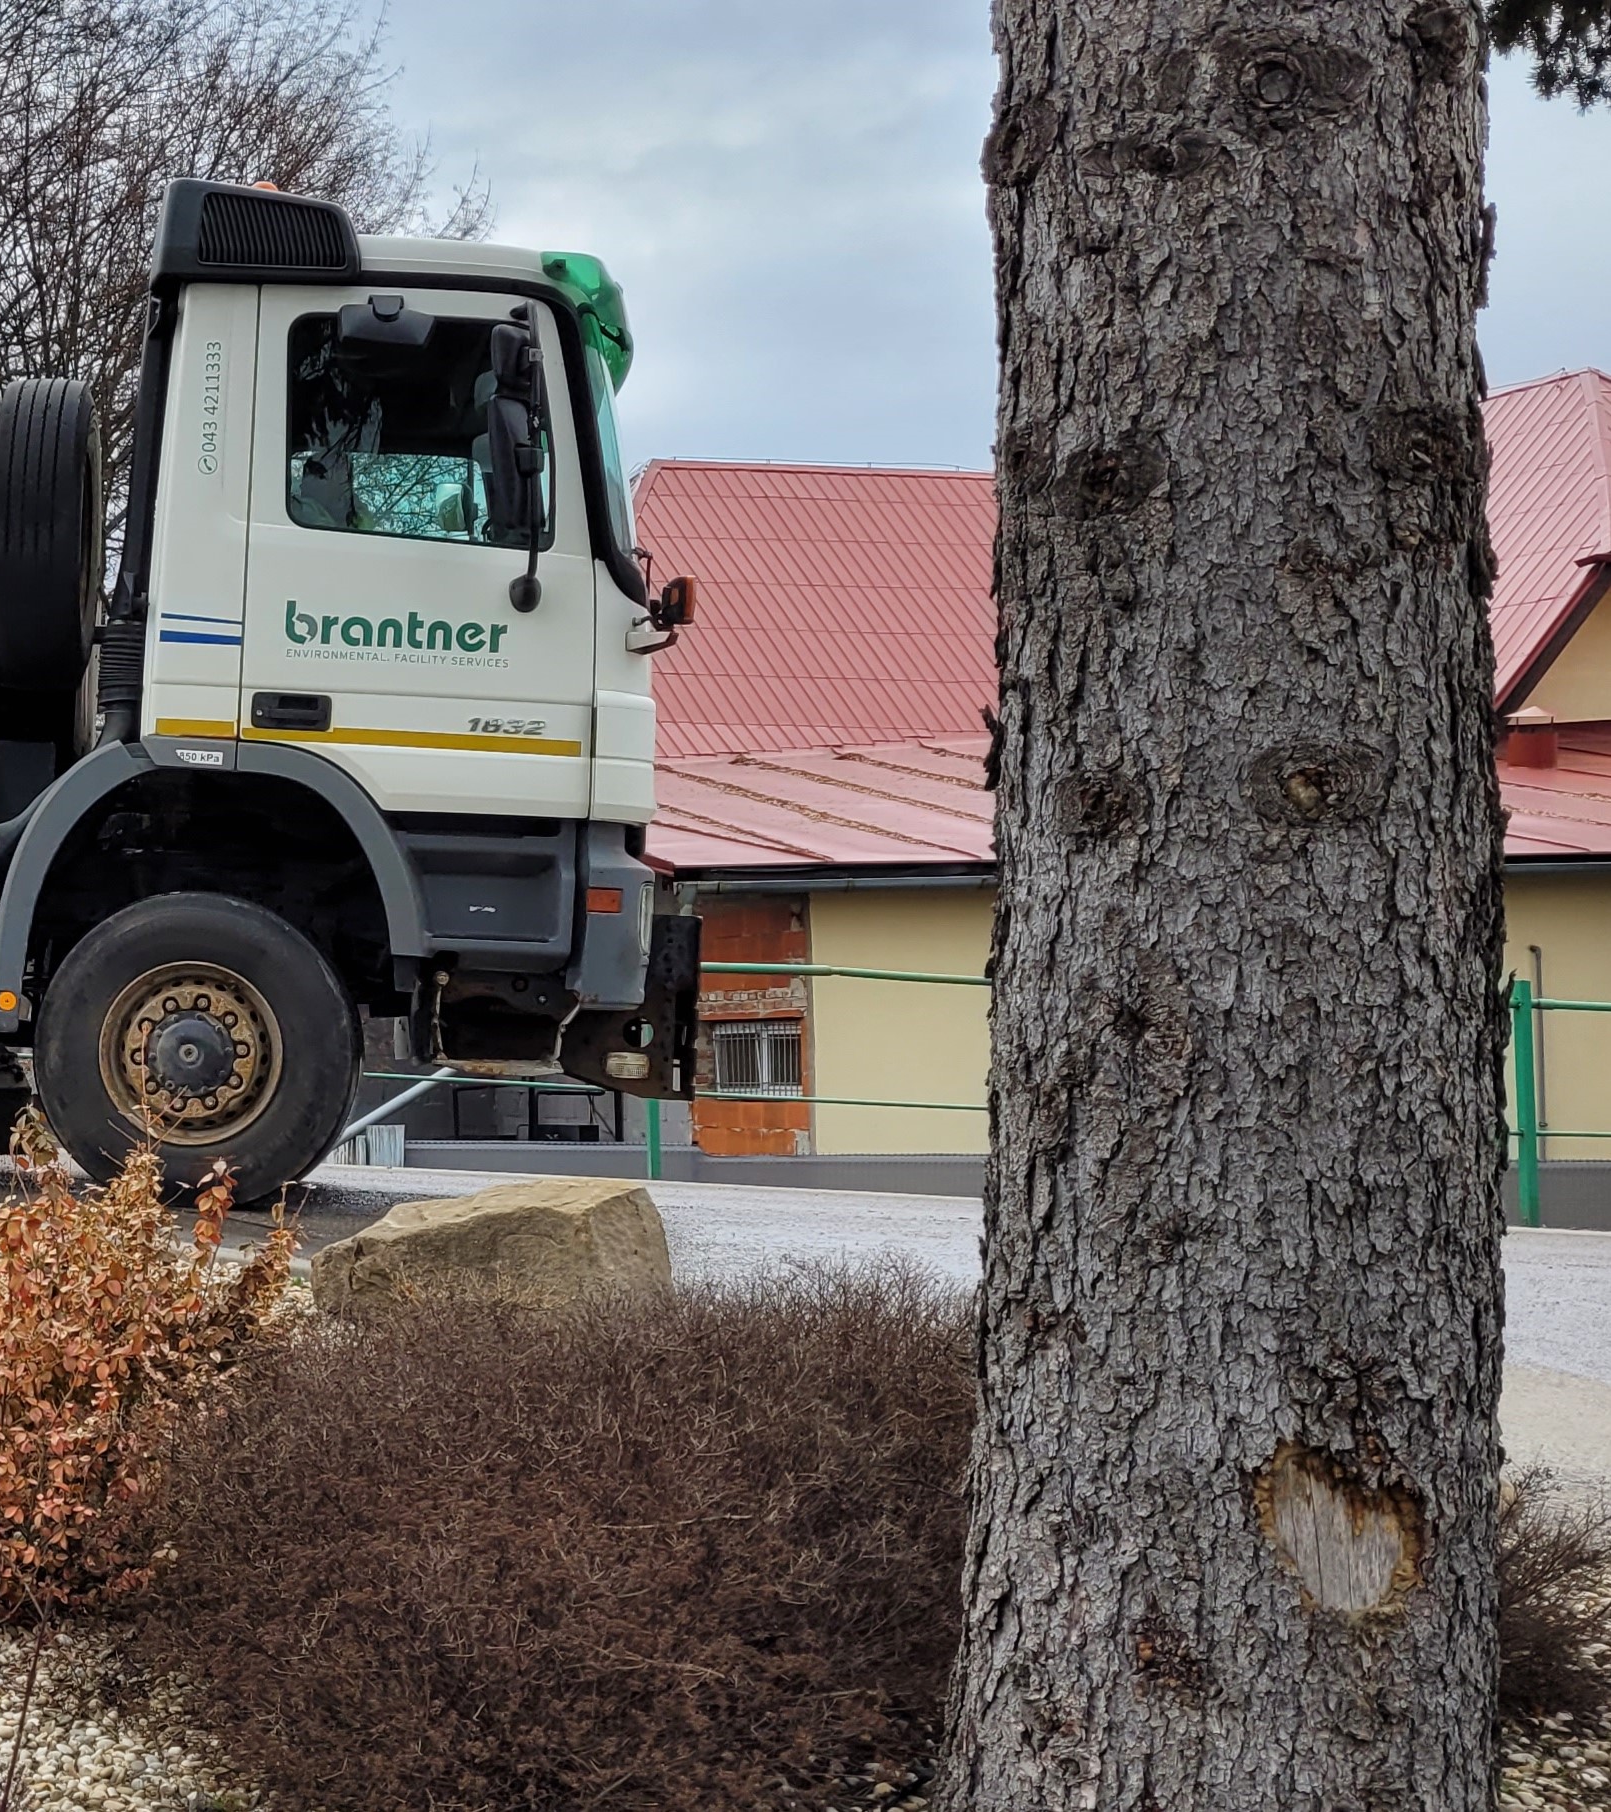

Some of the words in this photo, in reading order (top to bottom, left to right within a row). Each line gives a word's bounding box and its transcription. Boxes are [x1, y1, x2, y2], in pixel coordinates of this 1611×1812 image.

[203, 341, 222, 416] 4211333
[201, 421, 218, 453] 043
[284, 600, 508, 653] brantner
[394, 653, 447, 665] FACILITY
[451, 656, 509, 669] SERVICES
[467, 717, 547, 736] 1832
[200, 753, 220, 763] kPa
